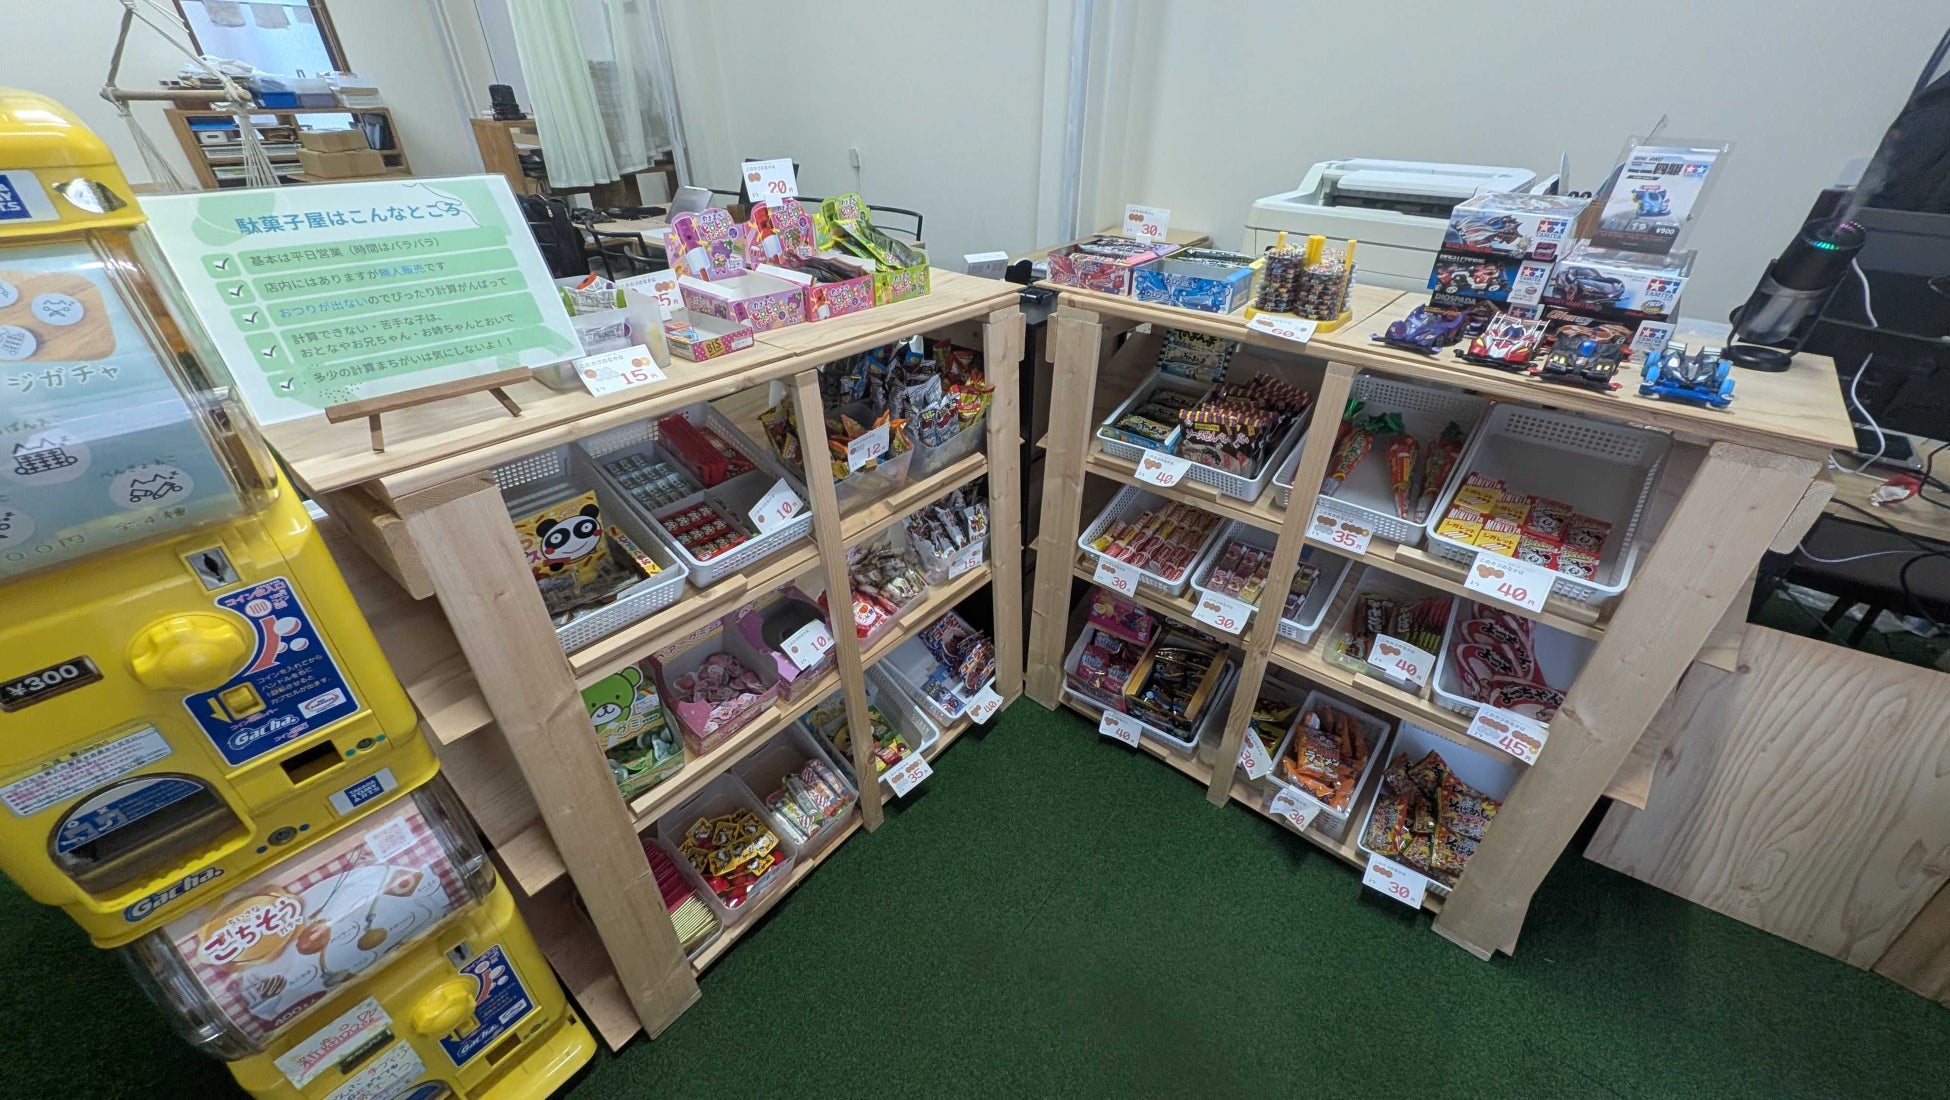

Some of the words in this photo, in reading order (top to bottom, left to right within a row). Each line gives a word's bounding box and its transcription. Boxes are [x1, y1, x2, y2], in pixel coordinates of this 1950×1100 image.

[768, 180, 787, 194] 20
[235, 202, 461, 234] 駄菓子屋はこんなところ
[1141, 223, 1158, 236] 30
[1536, 232, 1563, 240] TAMIYA
[265, 262, 445, 293] 店内にはありますが無人販売です
[1434, 293, 1477, 305] DIOSPADA
[1645, 291, 1674, 300] TAMIYA
[300, 314, 515, 358] おとなやお兄ちゃん・お姉ちゃんとおいで
[1271, 328, 1294, 338] 60
[620, 369, 649, 385] 15
[866, 443, 881, 459] 12
[1156, 471, 1173, 485] 40
[776, 501, 793, 520] 10
[1448, 507, 1484, 524] MINIVITA
[1484, 519, 1522, 535] MINIVITA
[1332, 530, 1357, 547] 35
[1483, 532, 1514, 546] シガレット
[963, 558, 976, 569] 15
[1479, 558, 1525, 575] このカゴのなかは
[1111, 576, 1127, 589] 30
[1496, 582, 1528, 601] 40
[1214, 615, 1235, 629] 30
[811, 635, 827, 651] 10
[1395, 659, 1417, 676] 40
[7, 664, 79, 698] ¥300
[983, 700, 997, 713] 40
[1115, 728, 1131, 740] 40
[1499, 736, 1528, 756] 45
[1241, 750, 1256, 768] 30
[907, 767, 924, 784] 35
[1289, 809, 1305, 825] 30
[1387, 881, 1410, 898] 30
[204, 900, 298, 961] ごちそう
